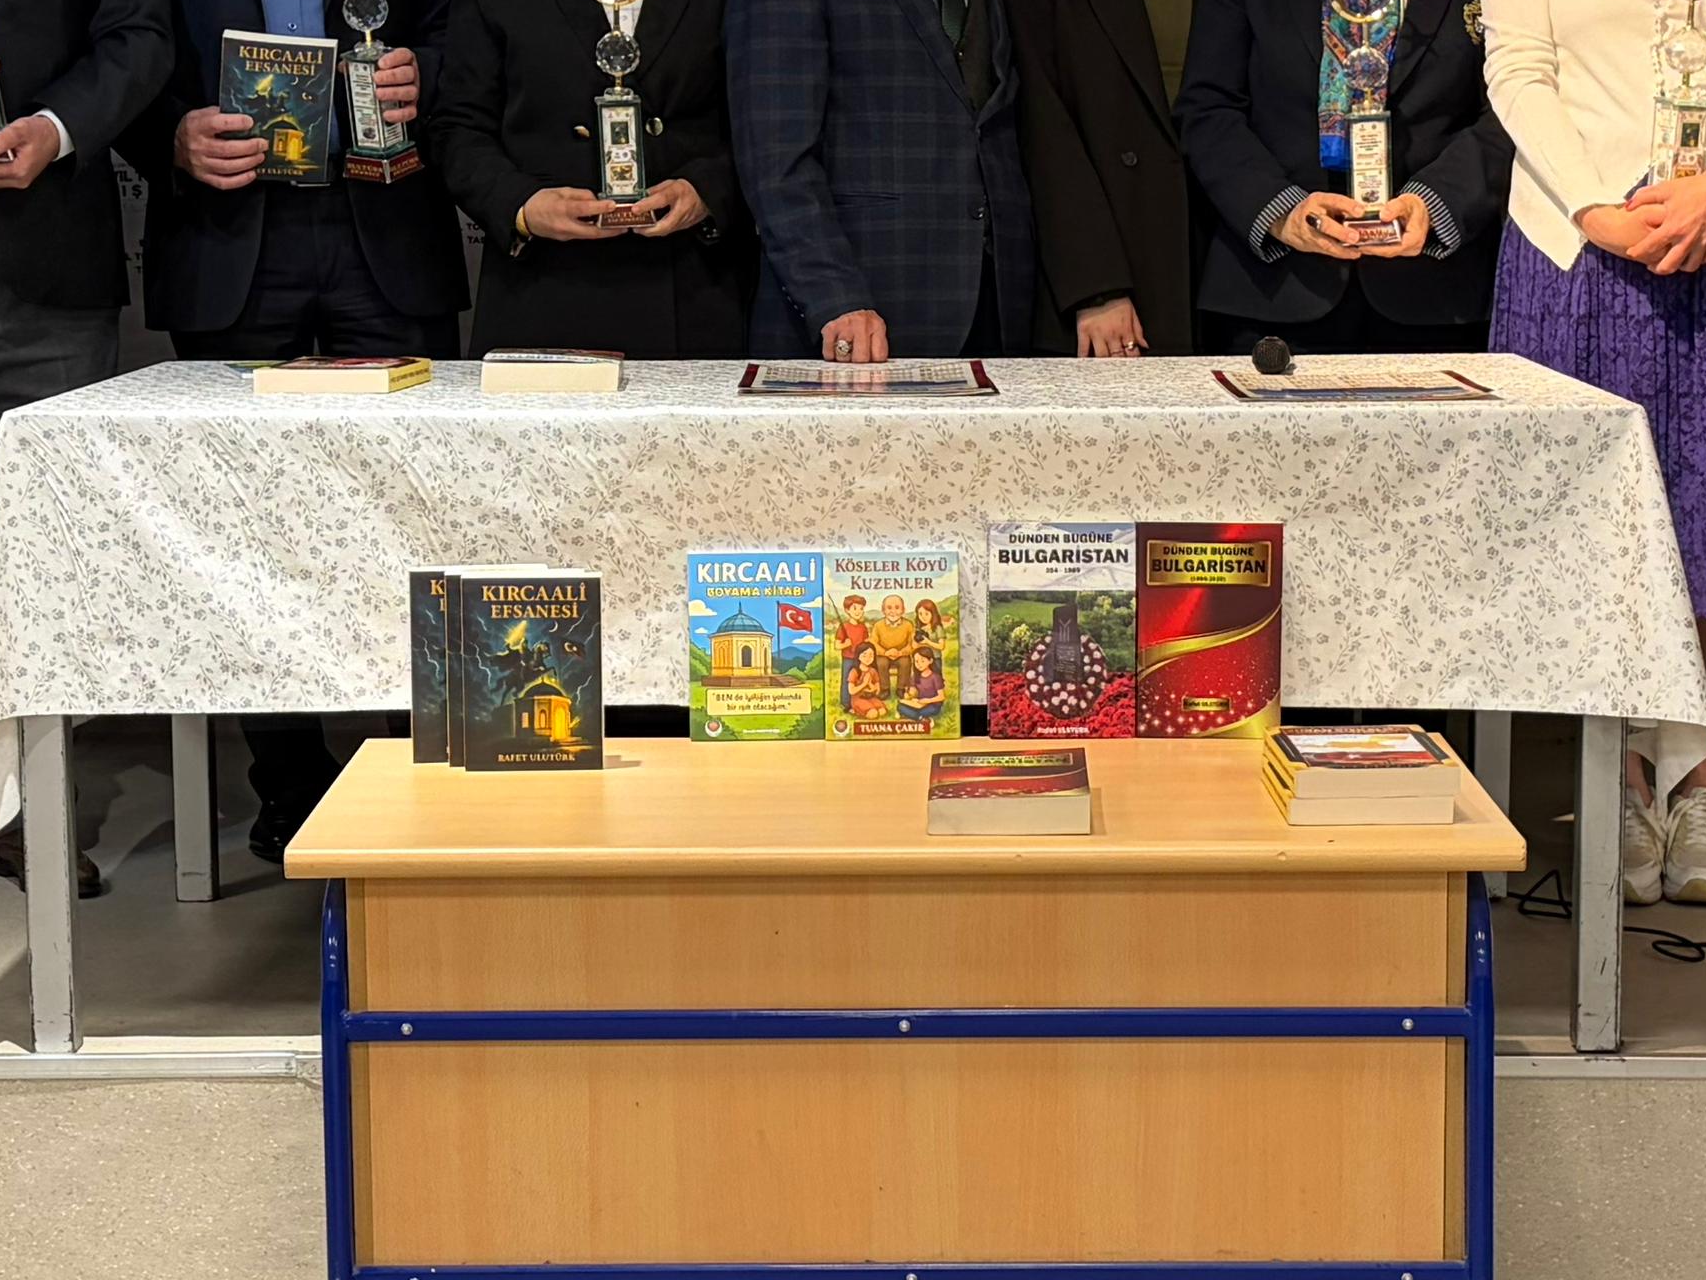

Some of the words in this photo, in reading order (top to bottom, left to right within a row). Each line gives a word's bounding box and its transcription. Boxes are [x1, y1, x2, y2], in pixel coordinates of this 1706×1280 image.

[239, 45, 323, 65] KIRCAALİ
[1009, 532, 1060, 544] DÜNDEN
[1063, 531, 1113, 544] BUGÜNE
[998, 545, 1129, 564] BULGARİSTAN
[1163, 544, 1207, 555] DÜNDEN
[697, 557, 816, 583] KIRCAALİ
[835, 558, 901, 573] KÖSELER
[906, 557, 948, 572] KÖYÜ
[1152, 556, 1266, 573] BULGARİSTAN
[850, 575, 934, 590] KUZENLER
[481, 582, 587, 602] KIRCAALİ
[490, 602, 580, 619] EFSANESİ
